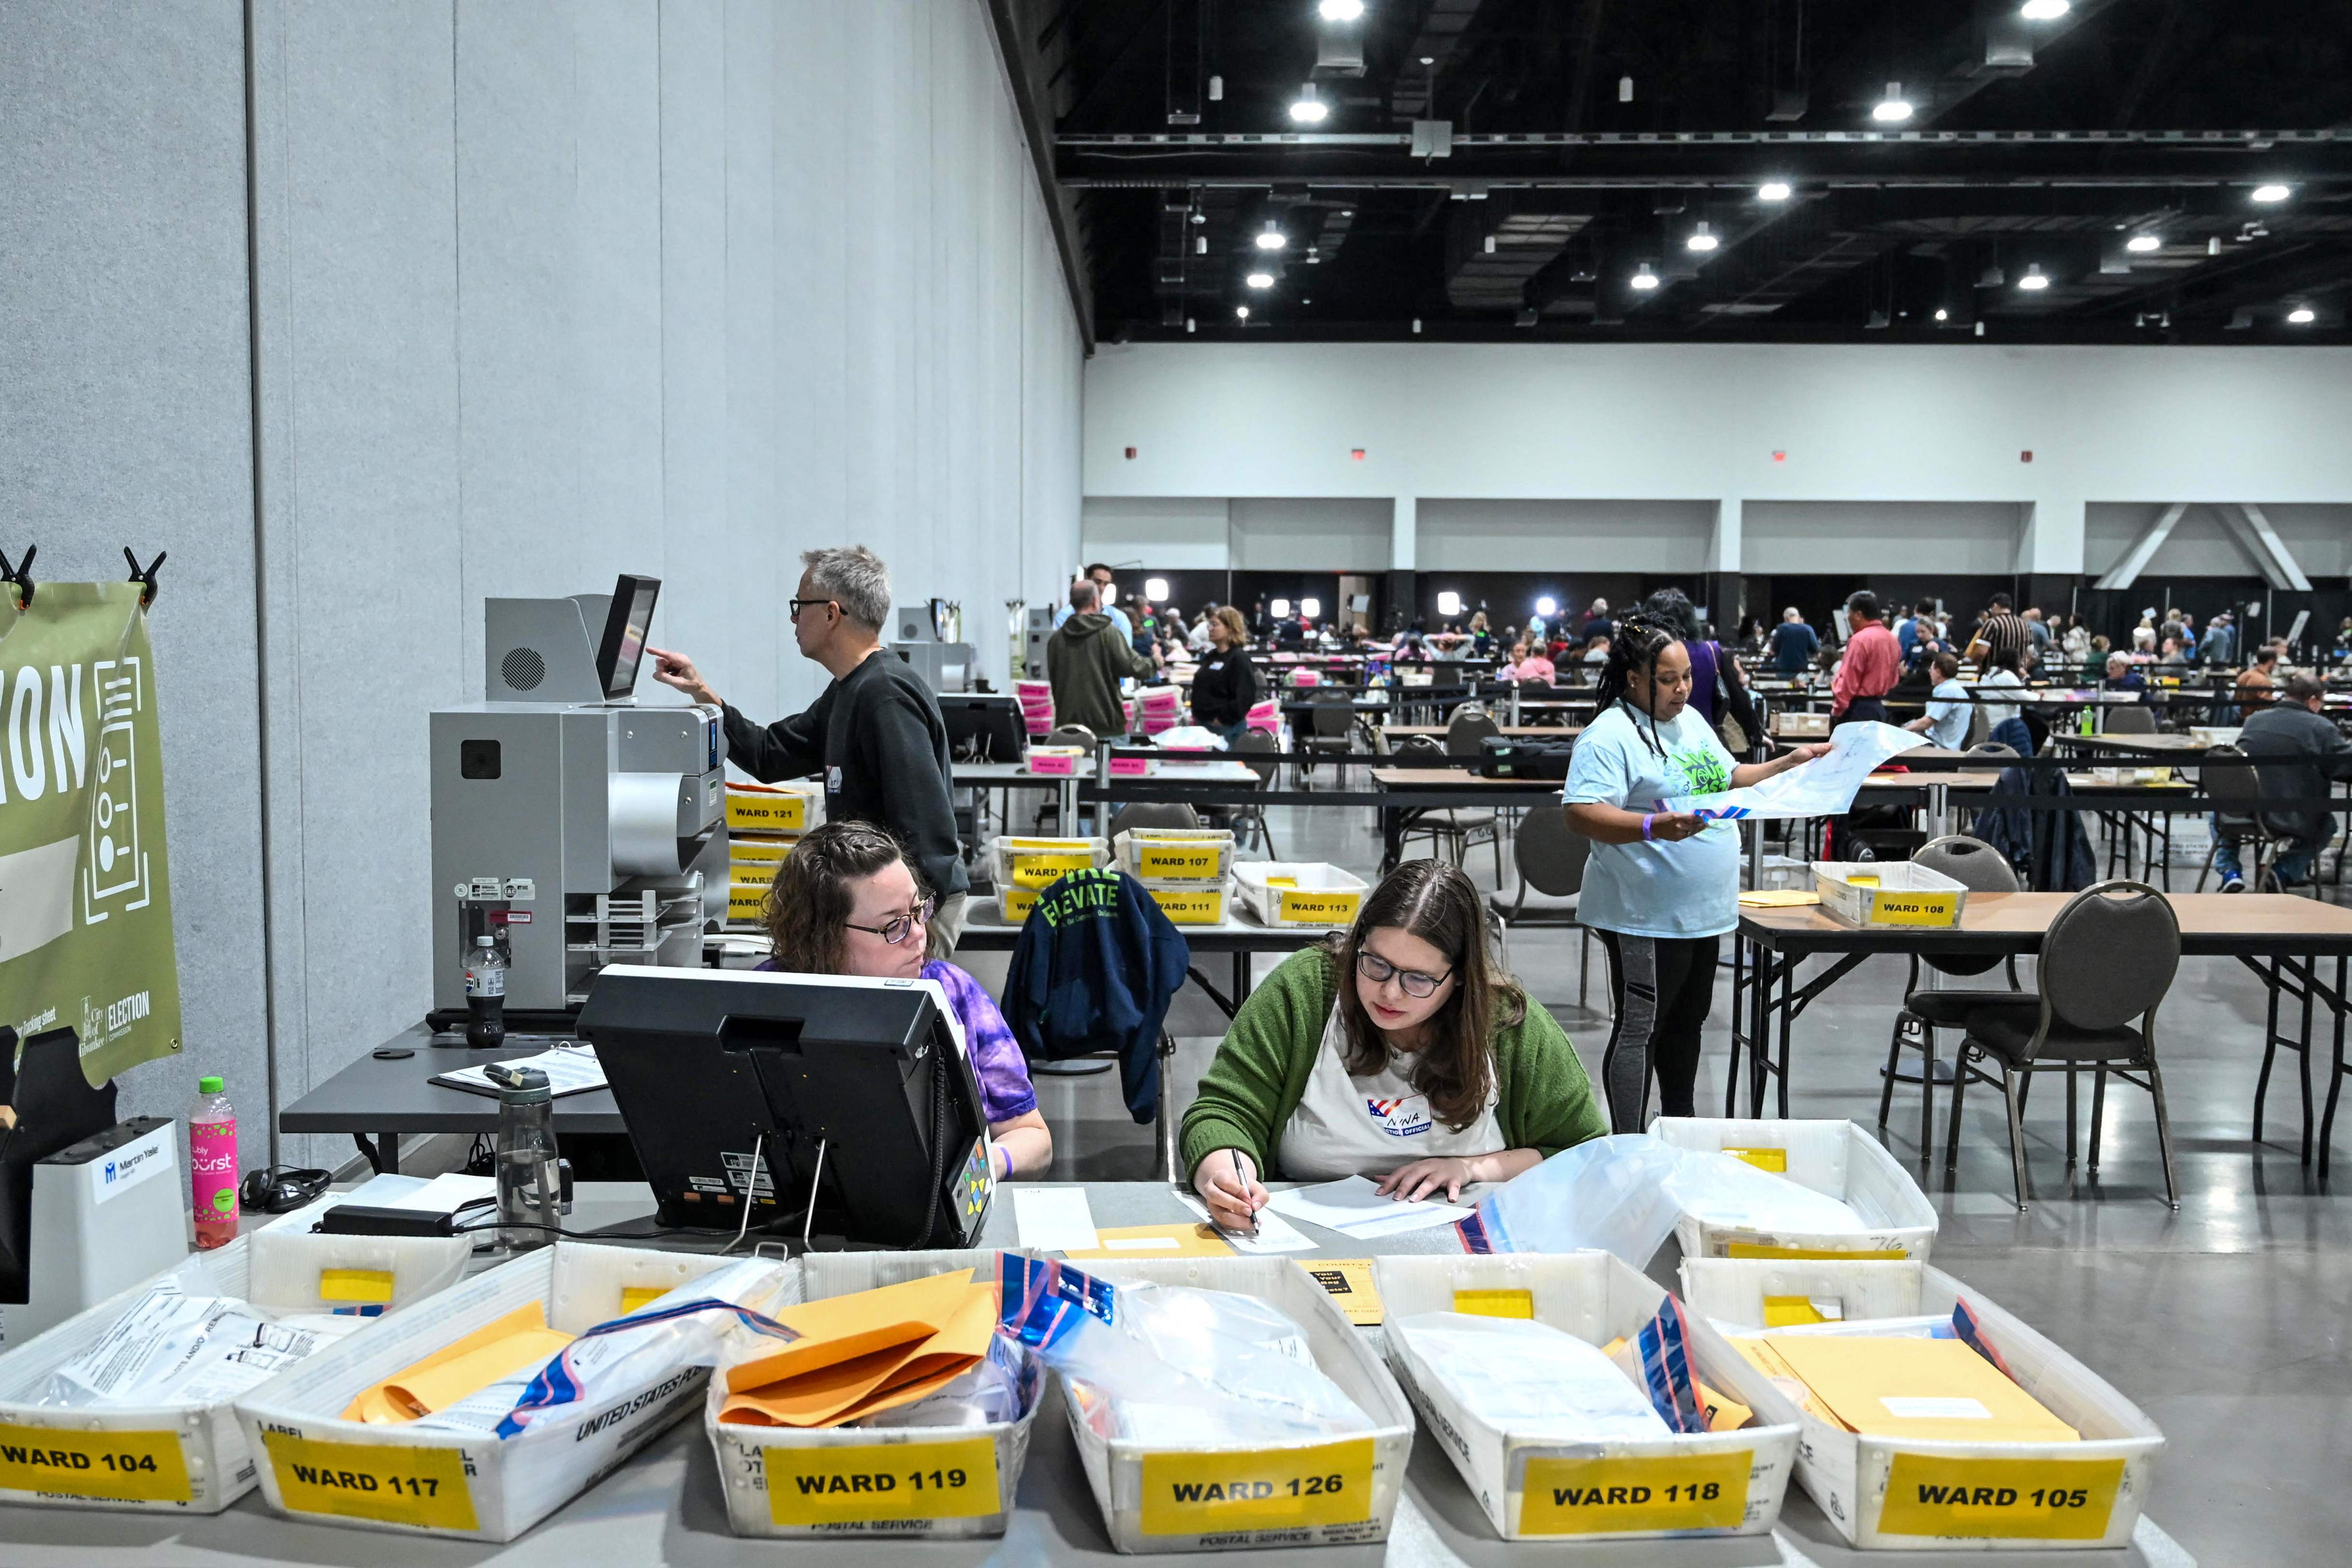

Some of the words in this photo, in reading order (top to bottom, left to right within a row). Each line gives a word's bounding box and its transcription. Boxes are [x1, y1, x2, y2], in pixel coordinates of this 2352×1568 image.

[1671, 748, 1719, 769] LIVE
[1682, 764, 1727, 786] YOUR
[736, 808, 769, 817] WARD
[1151, 857, 1184, 865] WARD
[1024, 868, 1058, 877] WARD
[1042, 883, 1118, 927] ELEVATE
[1292, 903, 1324, 911] WARD
[1884, 904, 1919, 912] WARD
[42, 1006, 56, 1026] sheet
[92, 1008, 103, 1023] City
[108, 990, 150, 1031] ELECTION
[92, 1022, 98, 1035] of
[109, 1024, 131, 1041] COMMISSION
[1387, 1112, 1420, 1126] NINA
[120, 1154, 144, 1172] Martin
[143, 1145, 159, 1159] Yale
[185, 1336, 205, 1361] AND/O
[576, 1401, 631, 1442] UNITED
[630, 1373, 681, 1415] STATES
[1, 1445, 91, 1469] WARD
[101, 1453, 157, 1473] 104
[292, 1464, 378, 1491] WARD
[388, 1476, 439, 1497] 117
[796, 1473, 896, 1494] WARD
[909, 1469, 967, 1489] 119
[1173, 1481, 1273, 1502] WARD
[1287, 1474, 1343, 1496] 126
[1554, 1487, 1651, 1506] WARD
[1664, 1483, 1720, 1502] 118
[1918, 1485, 2017, 1506] WARD
[2030, 1489, 2089, 1507] 105
[1199, 1532, 1251, 1546] POSTAL
[1255, 1531, 1313, 1542] SERVICE
